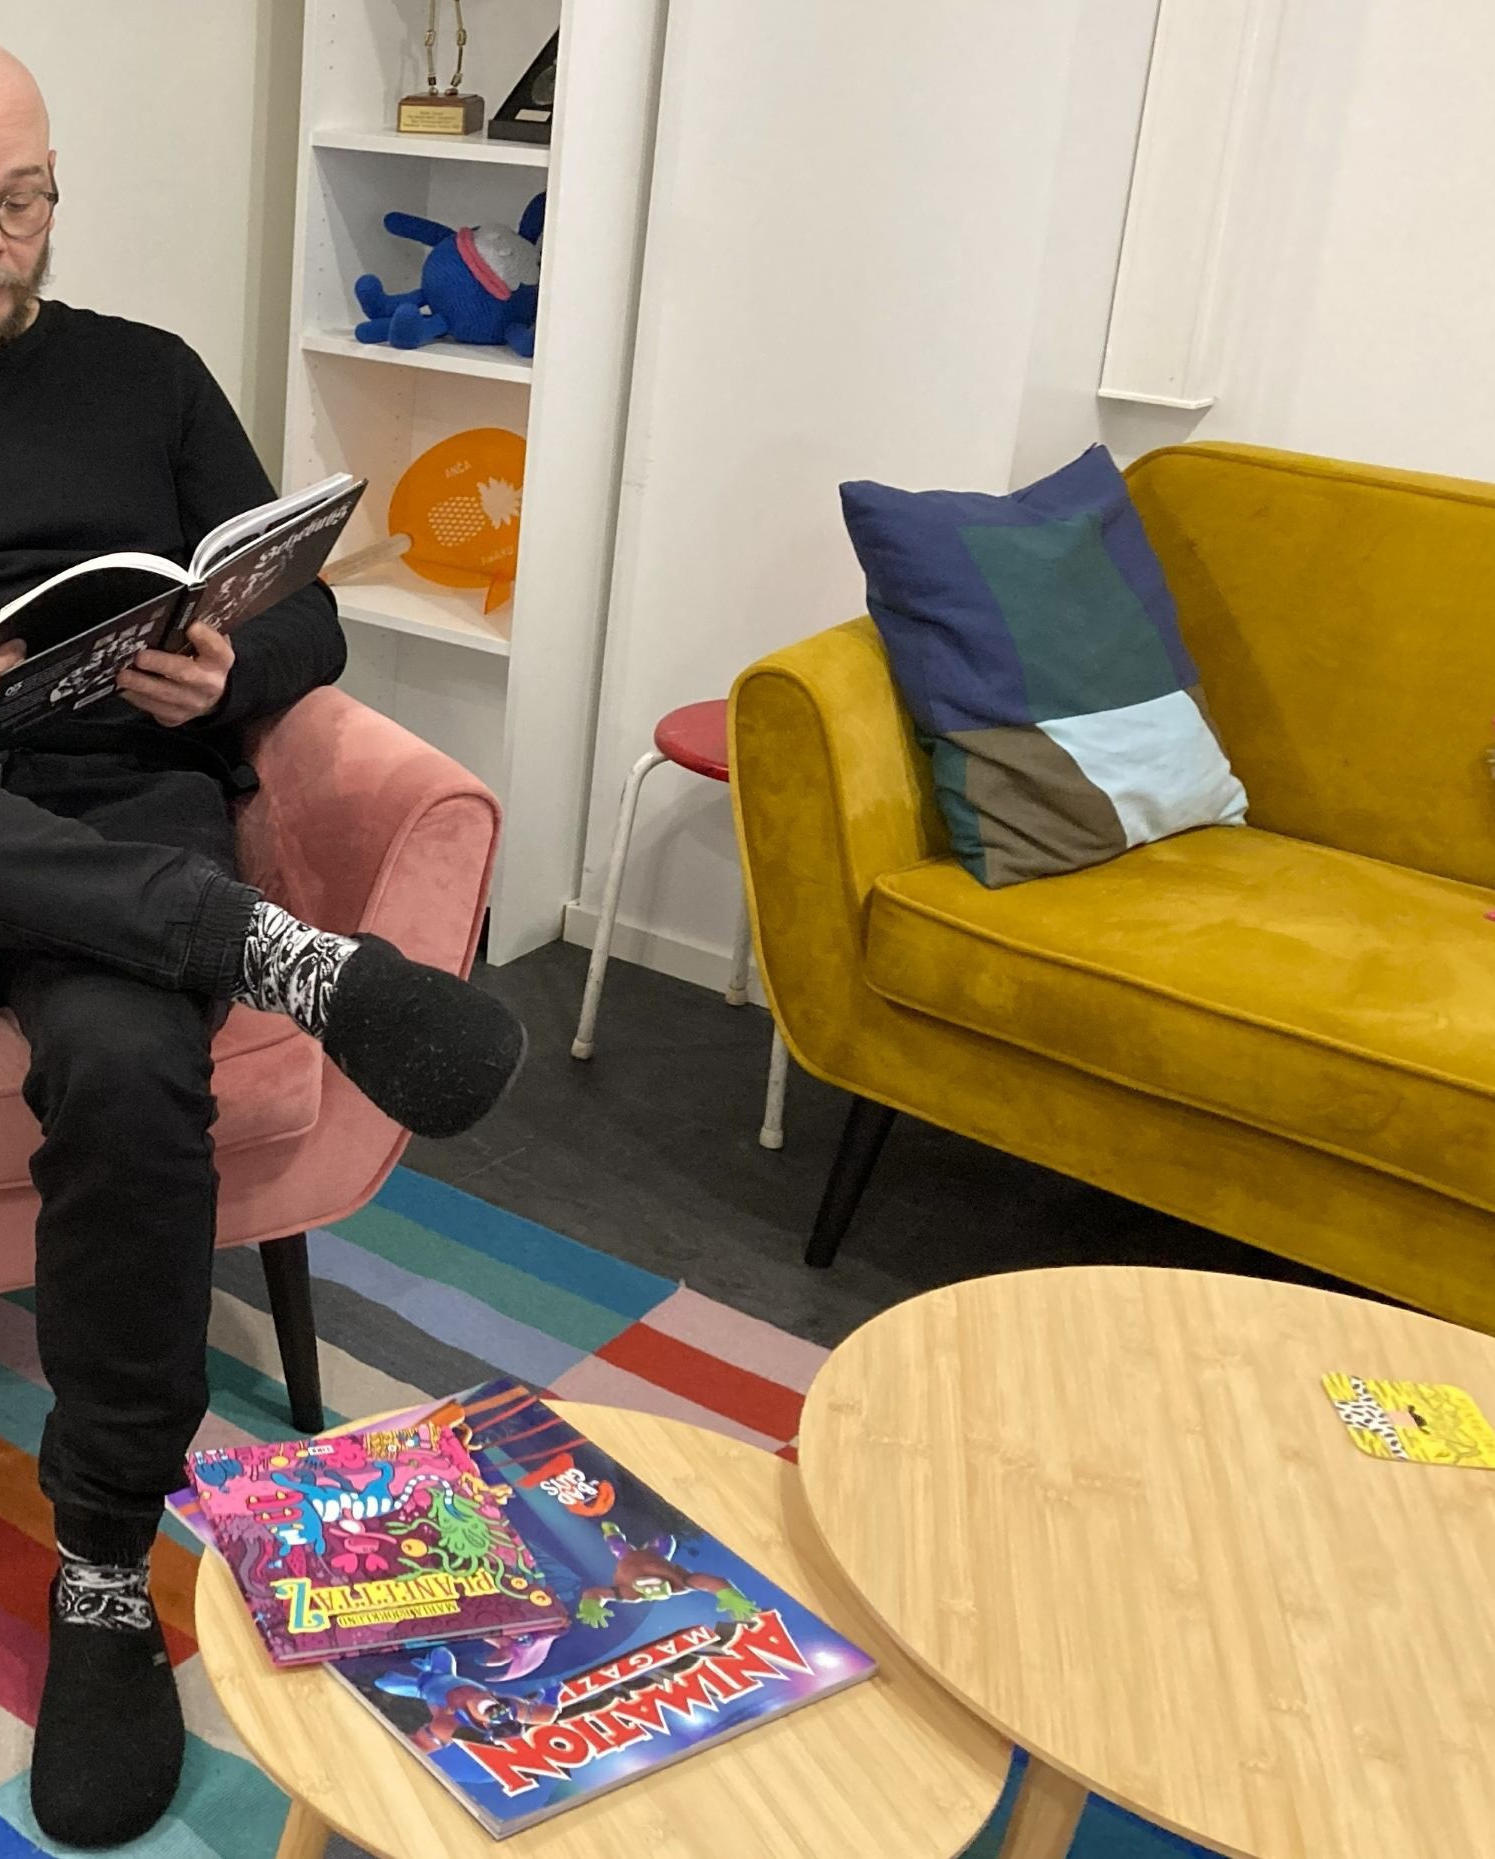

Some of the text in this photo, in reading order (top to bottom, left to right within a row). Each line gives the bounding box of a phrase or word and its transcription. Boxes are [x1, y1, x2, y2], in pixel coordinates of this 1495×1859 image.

[540, 1468, 586, 1496] GUYS
[558, 1481, 598, 1505] BAD
[272, 1579, 329, 1633] Z
[415, 1601, 459, 1618] MARIA
[561, 1626, 711, 1699] MAGAZI
[452, 1609, 815, 1797] ANIMATION
